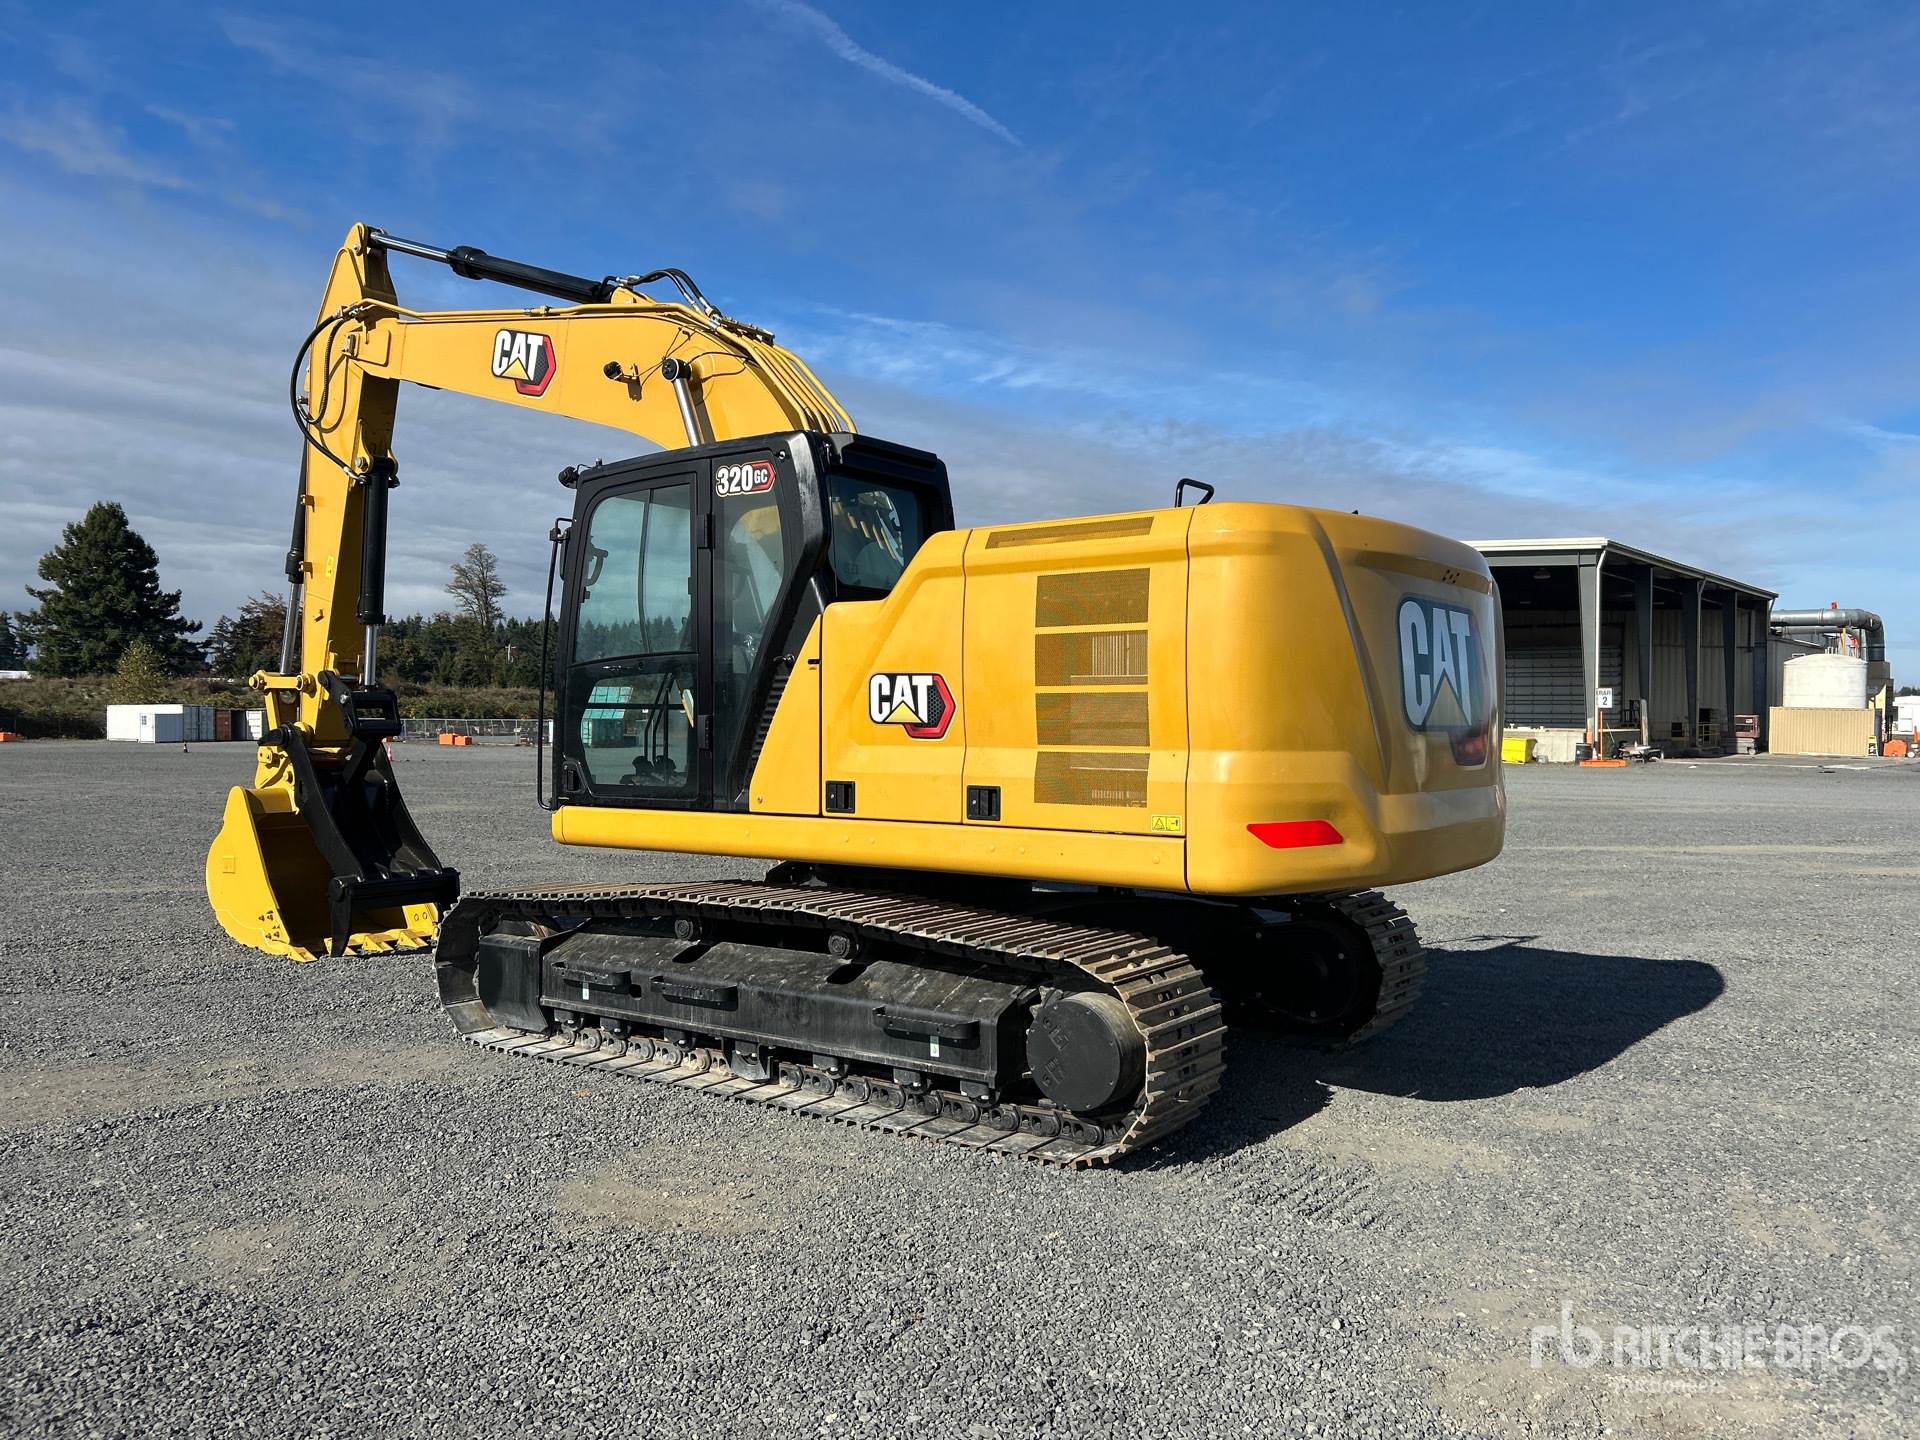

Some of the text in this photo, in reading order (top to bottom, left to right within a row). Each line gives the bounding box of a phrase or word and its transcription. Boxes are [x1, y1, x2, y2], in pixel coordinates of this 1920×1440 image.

[492, 329, 544, 381] CAT
[717, 464, 768, 494] 320 GC
[1399, 600, 1472, 726] CAT
[870, 674, 933, 724] CAT
[1602, 696, 1608, 706] 2
